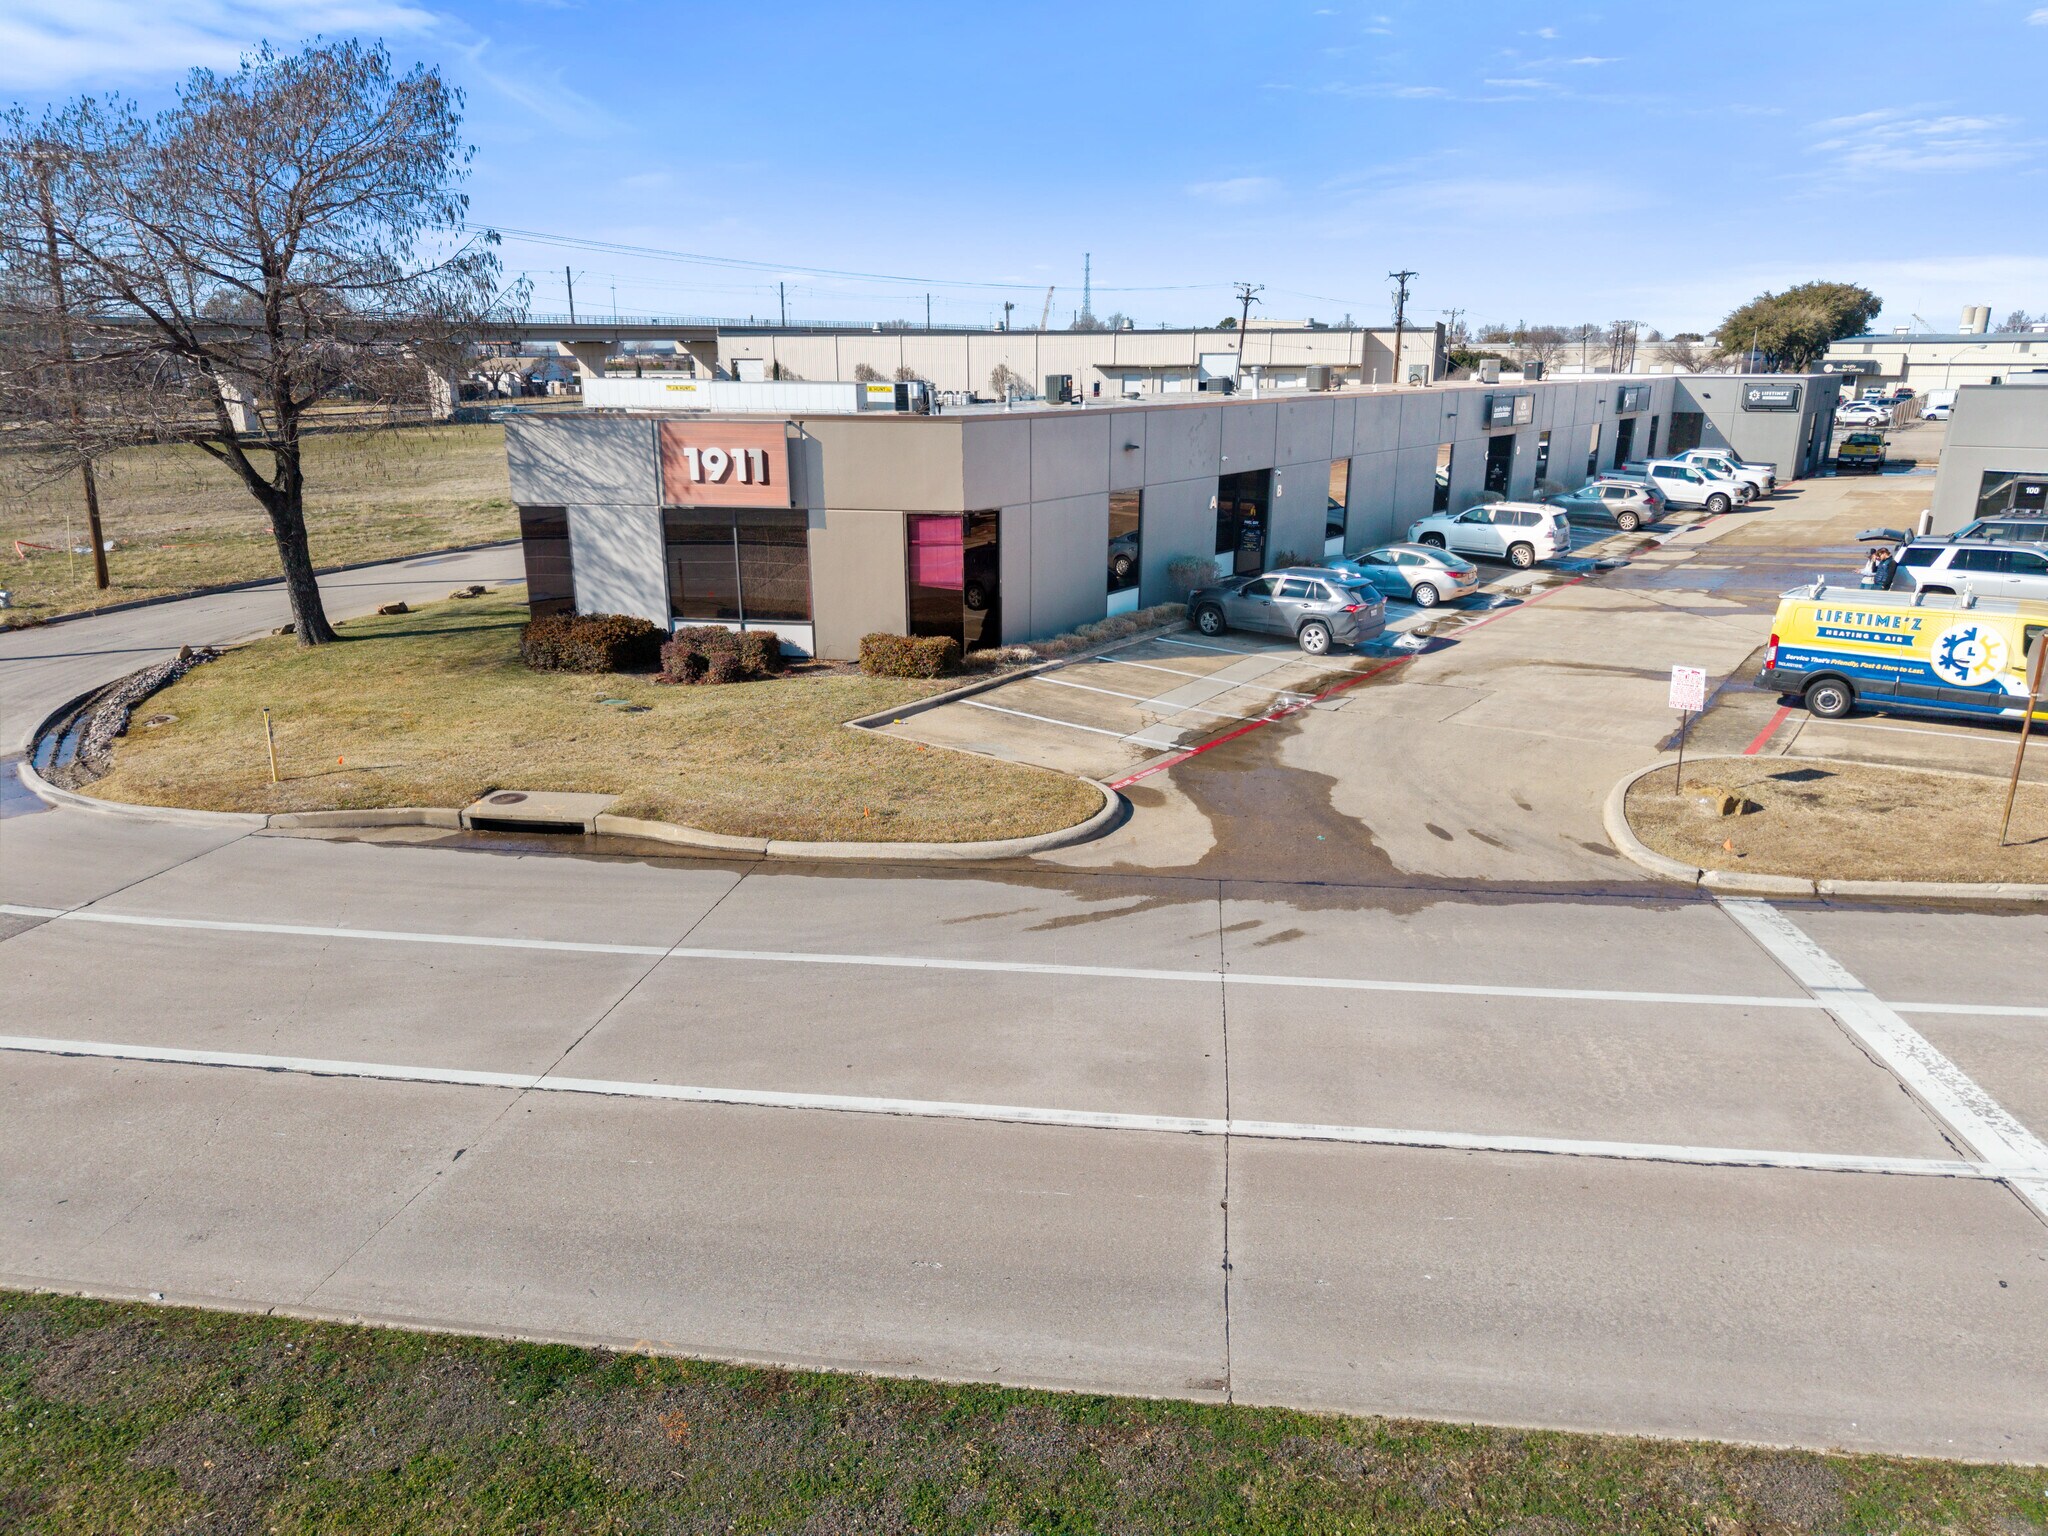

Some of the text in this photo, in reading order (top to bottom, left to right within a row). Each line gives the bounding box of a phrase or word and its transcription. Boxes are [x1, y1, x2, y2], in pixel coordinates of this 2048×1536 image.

[1705, 422, 1713, 430] G
[684, 447, 764, 482] 1911
[1277, 485, 1282, 497] B
[1210, 496, 1217, 509] A
[1816, 609, 1922, 630] LIFETIME'Z
[1825, 629, 1870, 640] HEATING
[1884, 635, 1904, 643] AIR
[1785, 653, 1810, 662] Service
[1810, 656, 1831, 664] That's
[1831, 659, 1859, 668] Friendly,
[1881, 664, 1899, 672] Here
[1908, 667, 1926, 675] Last.
